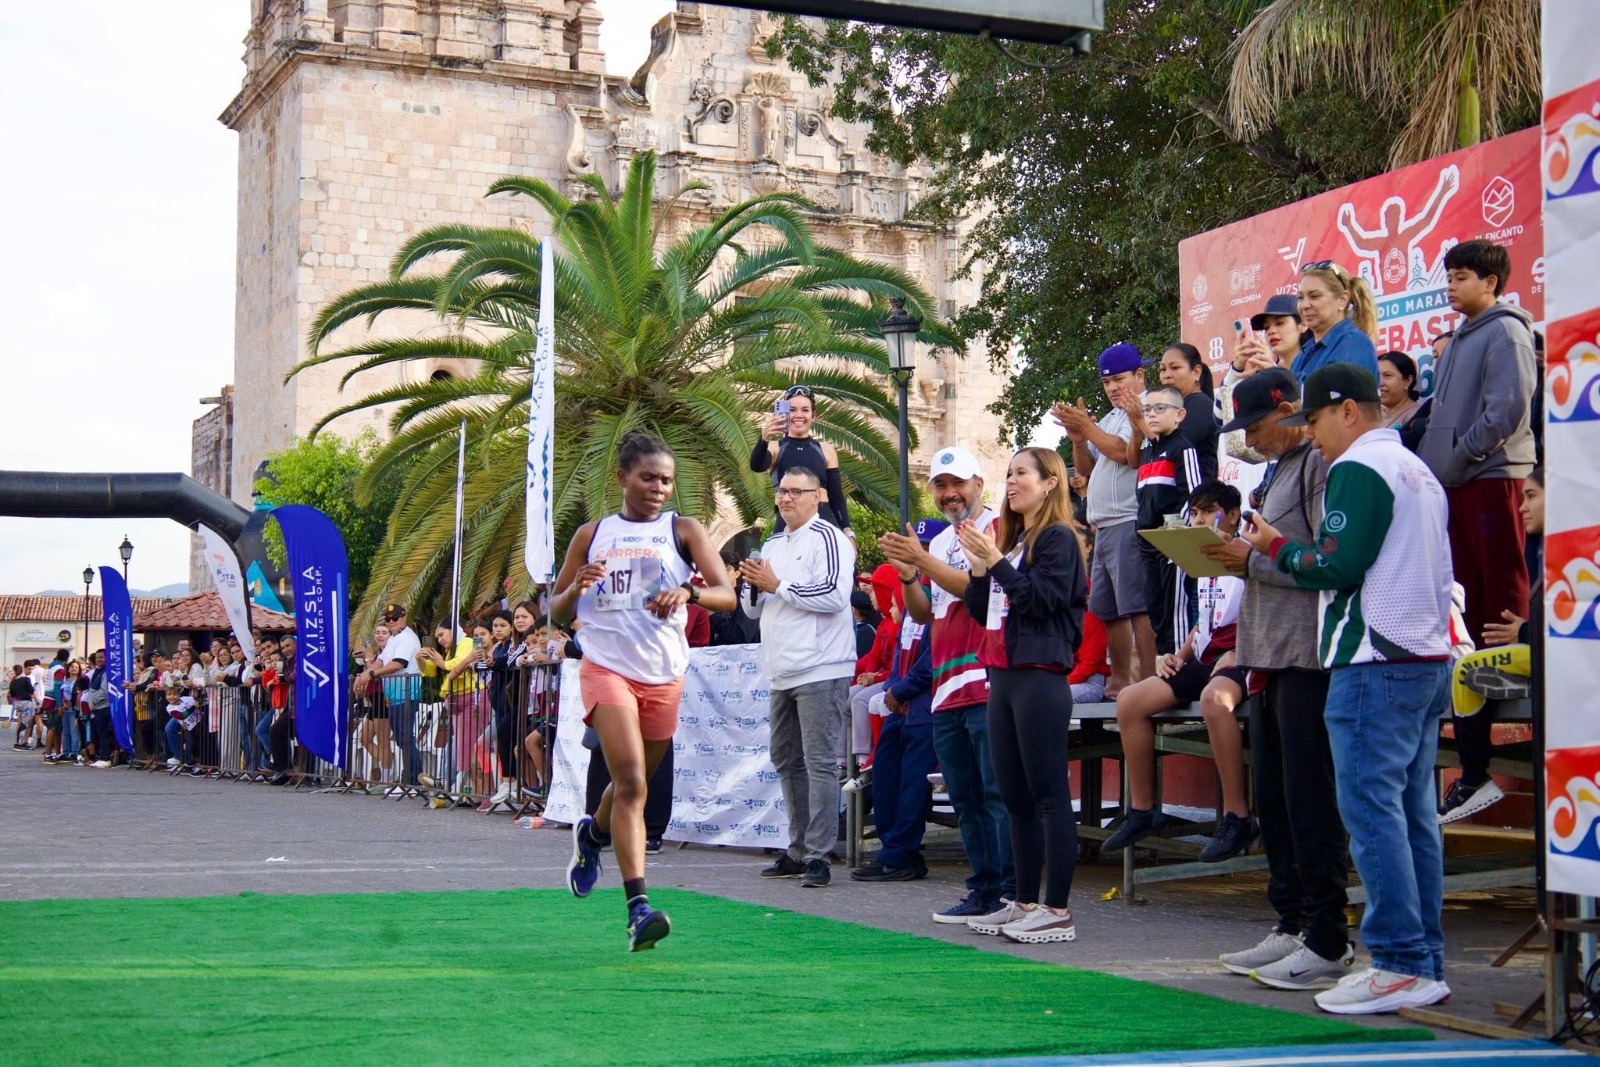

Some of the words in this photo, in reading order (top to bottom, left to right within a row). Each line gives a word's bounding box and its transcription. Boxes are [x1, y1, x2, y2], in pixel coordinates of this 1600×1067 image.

[1485, 225, 1523, 241] ENCANTO
[1276, 283, 1300, 295] VIZS
[1230, 293, 1262, 306] CONCORDIA
[1377, 304, 1399, 318] DIO
[1405, 291, 1448, 312] MARAT
[1188, 304, 1213, 316] CONCORDIA
[1375, 312, 1461, 357] EBAST
[917, 522, 925, 534] B
[652, 536, 667, 544] 60
[596, 548, 661, 559] CARRERA
[610, 570, 632, 595] 167
[302, 566, 319, 657] VIZSLA
[318, 609, 326, 653] SILVER
[108, 612, 117, 680] VIZSLA
[762, 825, 779, 833] VIZSLA
